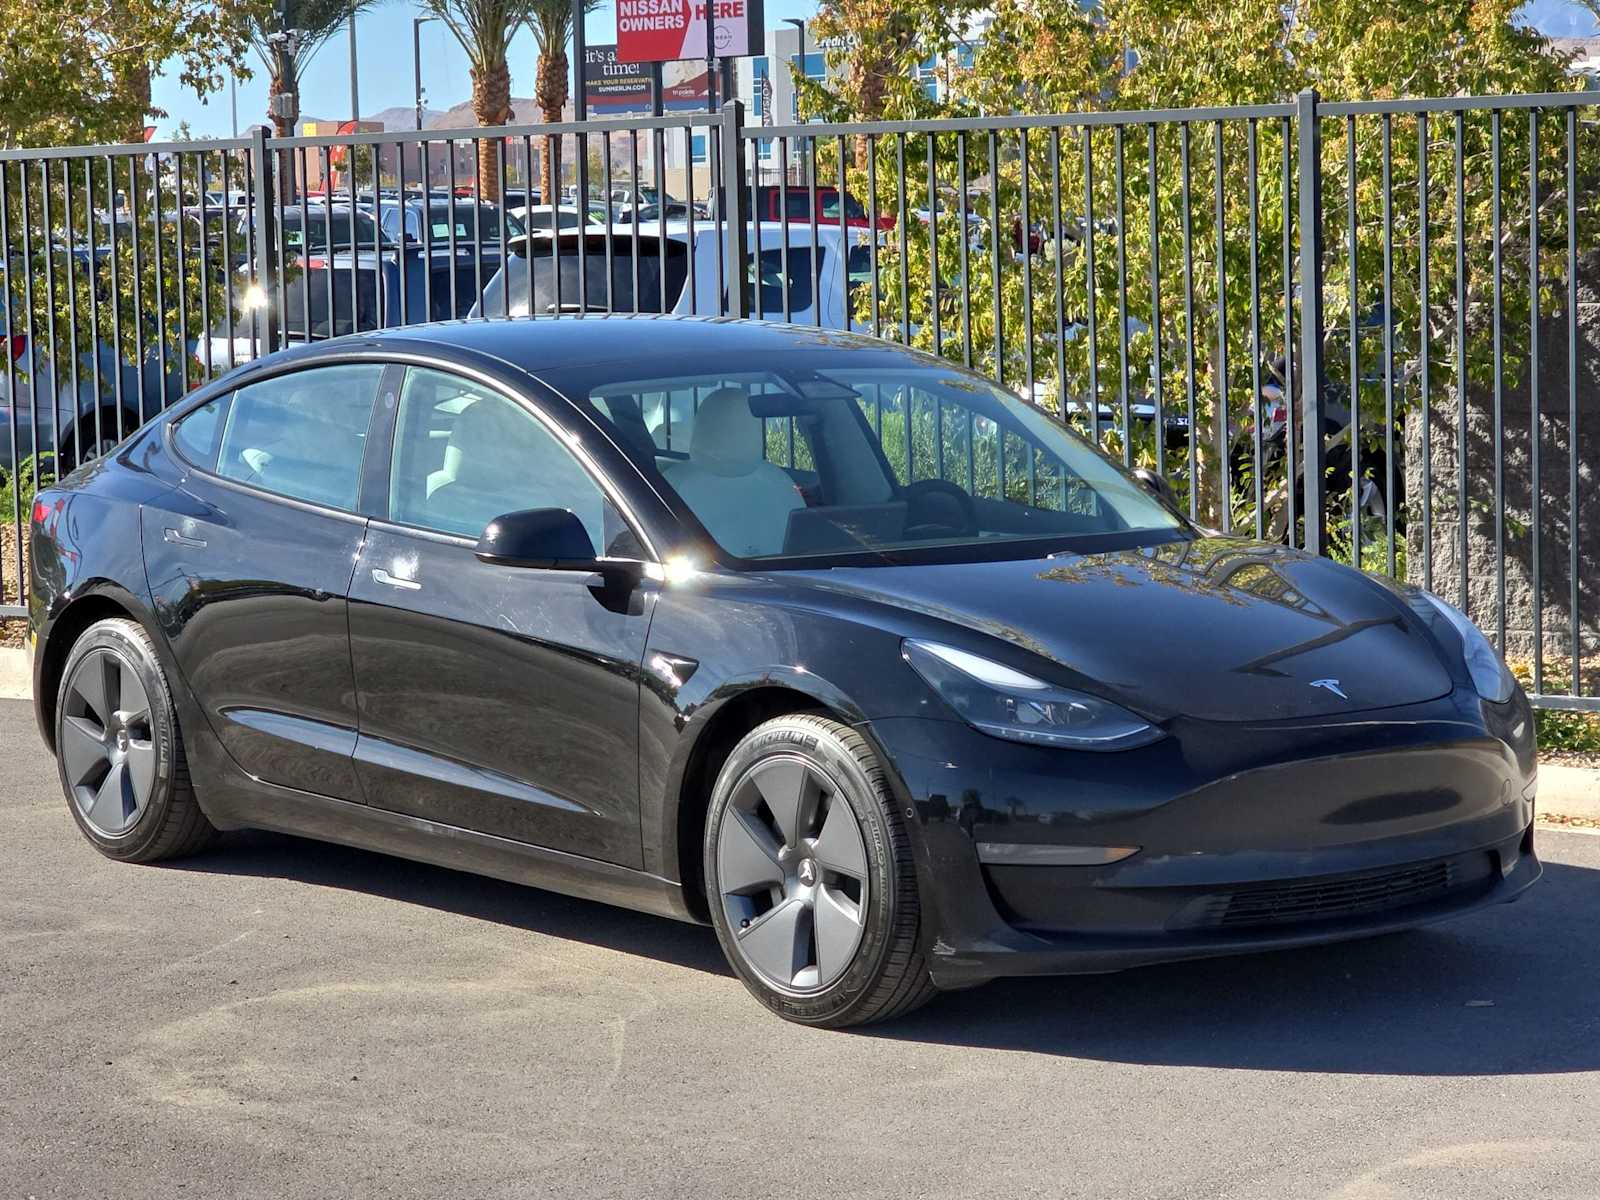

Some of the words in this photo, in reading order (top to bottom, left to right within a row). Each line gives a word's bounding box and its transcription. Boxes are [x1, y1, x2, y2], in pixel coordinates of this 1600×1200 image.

[620, 0, 683, 16] NISSAN
[695, 2, 744, 20] HERE
[620, 15, 684, 32] OWNERS
[585, 49, 605, 64] it's
[602, 62, 640, 75] time!
[598, 84, 646, 92] SUMMERLIN.COM
